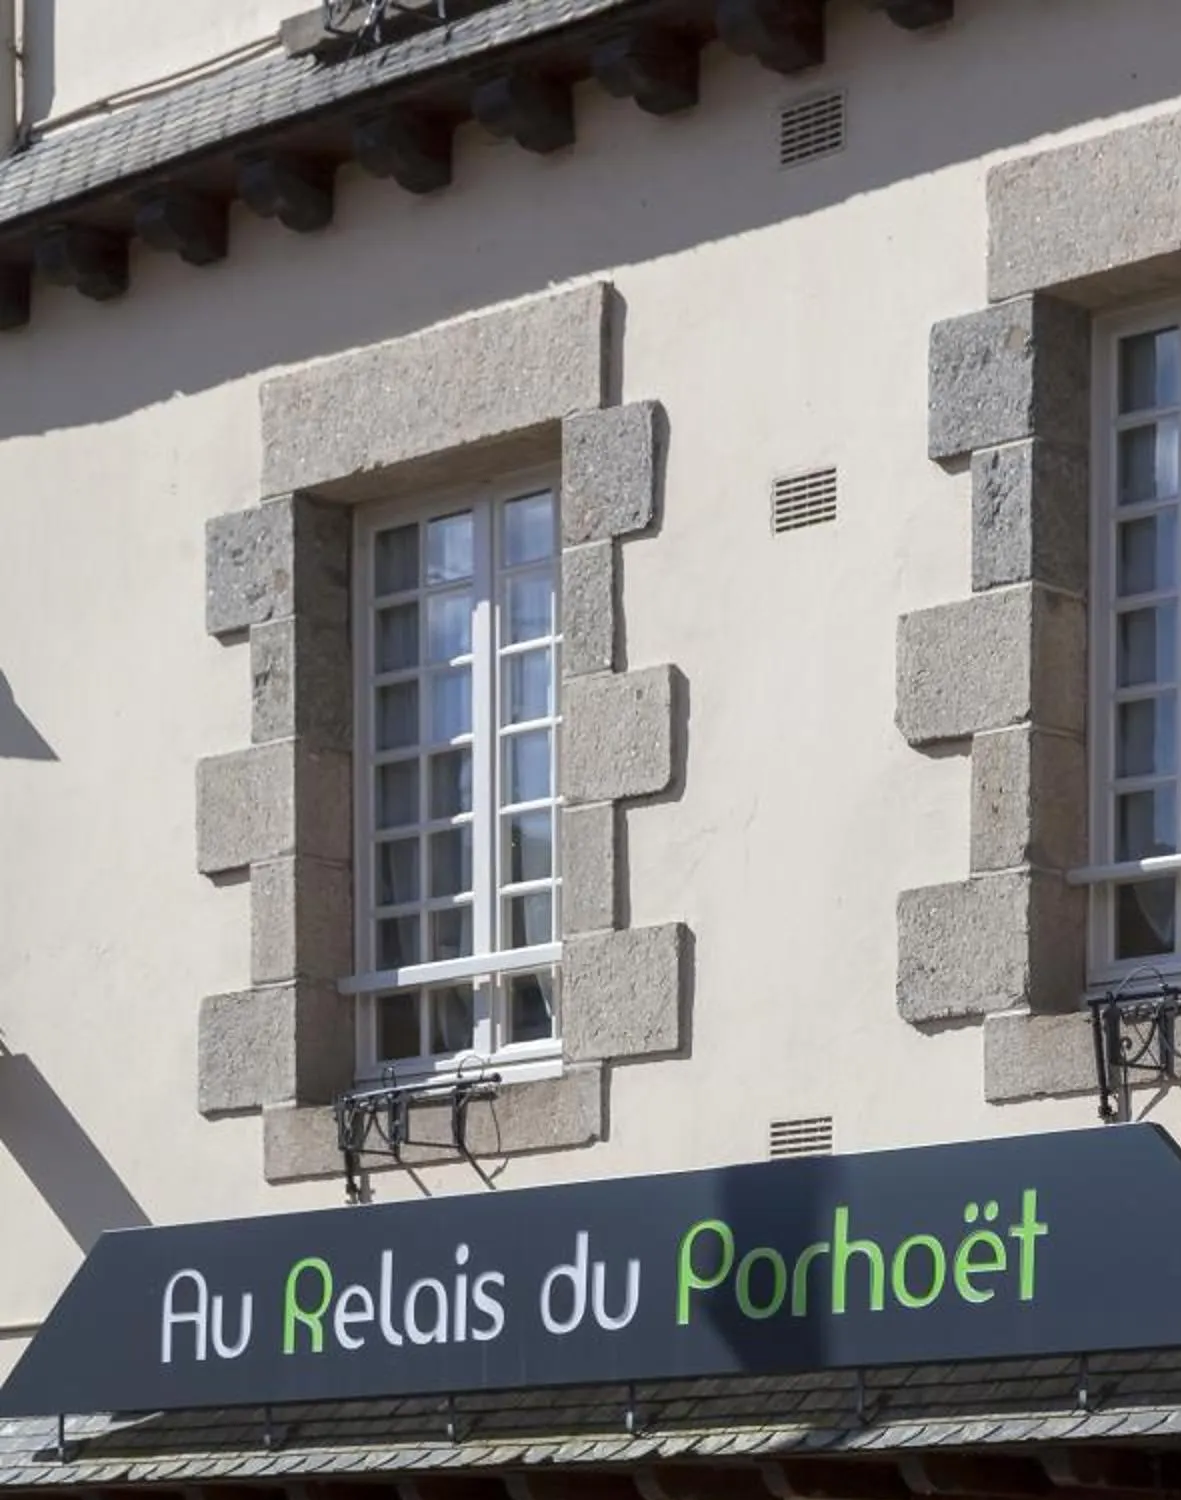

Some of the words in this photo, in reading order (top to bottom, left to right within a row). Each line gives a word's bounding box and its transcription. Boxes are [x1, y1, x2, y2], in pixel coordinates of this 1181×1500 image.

[161, 1268, 253, 1364] Au
[282, 1244, 506, 1354] Relais
[539, 1230, 641, 1336] du
[675, 1188, 1049, 1326] Porhoët
